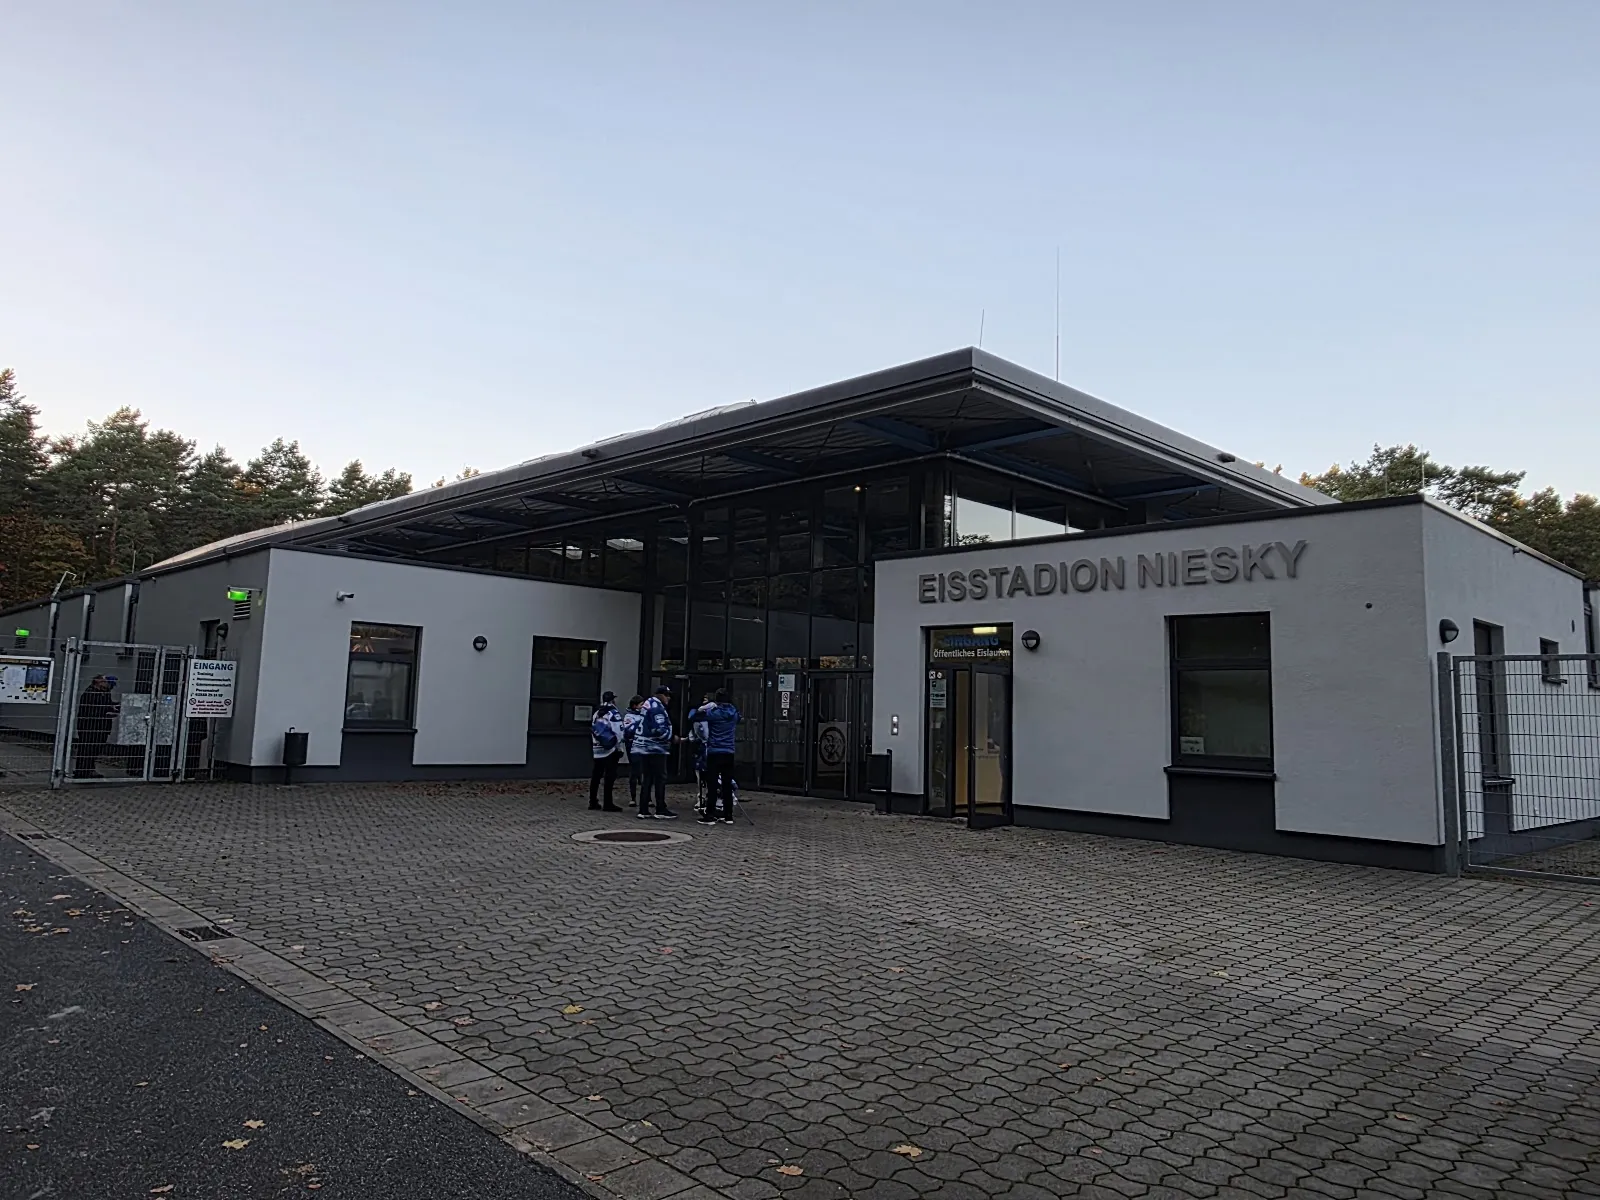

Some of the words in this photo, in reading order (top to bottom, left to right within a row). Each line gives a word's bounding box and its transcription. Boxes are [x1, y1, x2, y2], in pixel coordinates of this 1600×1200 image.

[918, 556, 1125, 604] EISSTADION
[1137, 540, 1309, 588] NIESKY
[933, 648, 975, 658] Öffentliches
[976, 647, 1011, 657] Eislaufen
[193, 662, 234, 671] EINGANG
